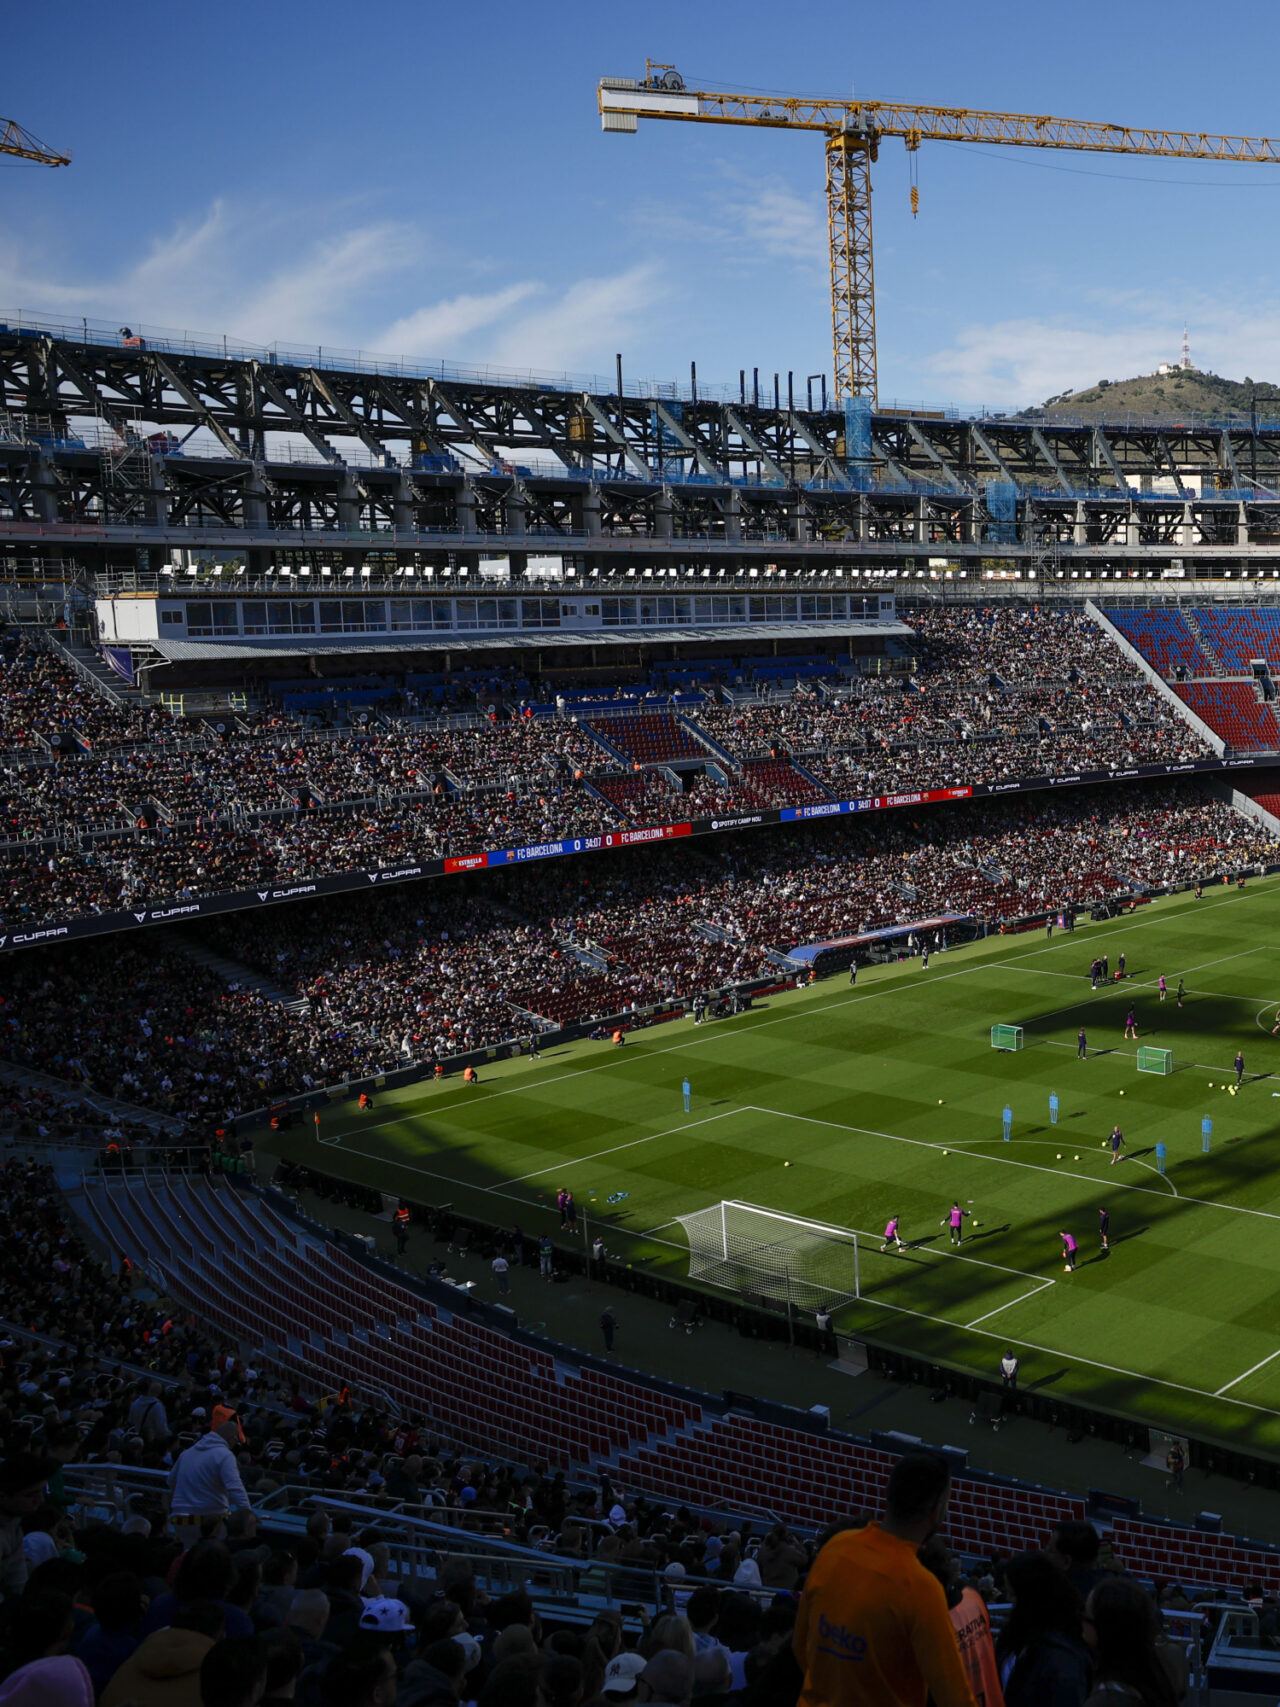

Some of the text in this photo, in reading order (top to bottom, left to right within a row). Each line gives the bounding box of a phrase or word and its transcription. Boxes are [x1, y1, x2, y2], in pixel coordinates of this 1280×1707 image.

[1115, 769, 1138, 777] CUPRA
[995, 783, 1020, 791] CUPRA
[803, 807, 811, 817] FC
[811, 803, 841, 816] BARCELONA
[849, 801, 855, 811] 0
[874, 798, 880, 808] 0
[886, 796, 894, 806] FC
[894, 793, 921, 805] BARCELONA
[718, 819, 737, 828] SPOTIFY
[517, 828, 664, 860] FC BARCELONA 0 34:07 0 FC BARCELONA
[458, 857, 482, 867] ESTRELLA
[381, 867, 421, 880] CUPRA
[272, 885, 316, 898] CUPRA
[151, 904, 200, 918] CUPRA
[13, 927, 68, 943] CUPRA
[818, 1613, 867, 1654] beko
